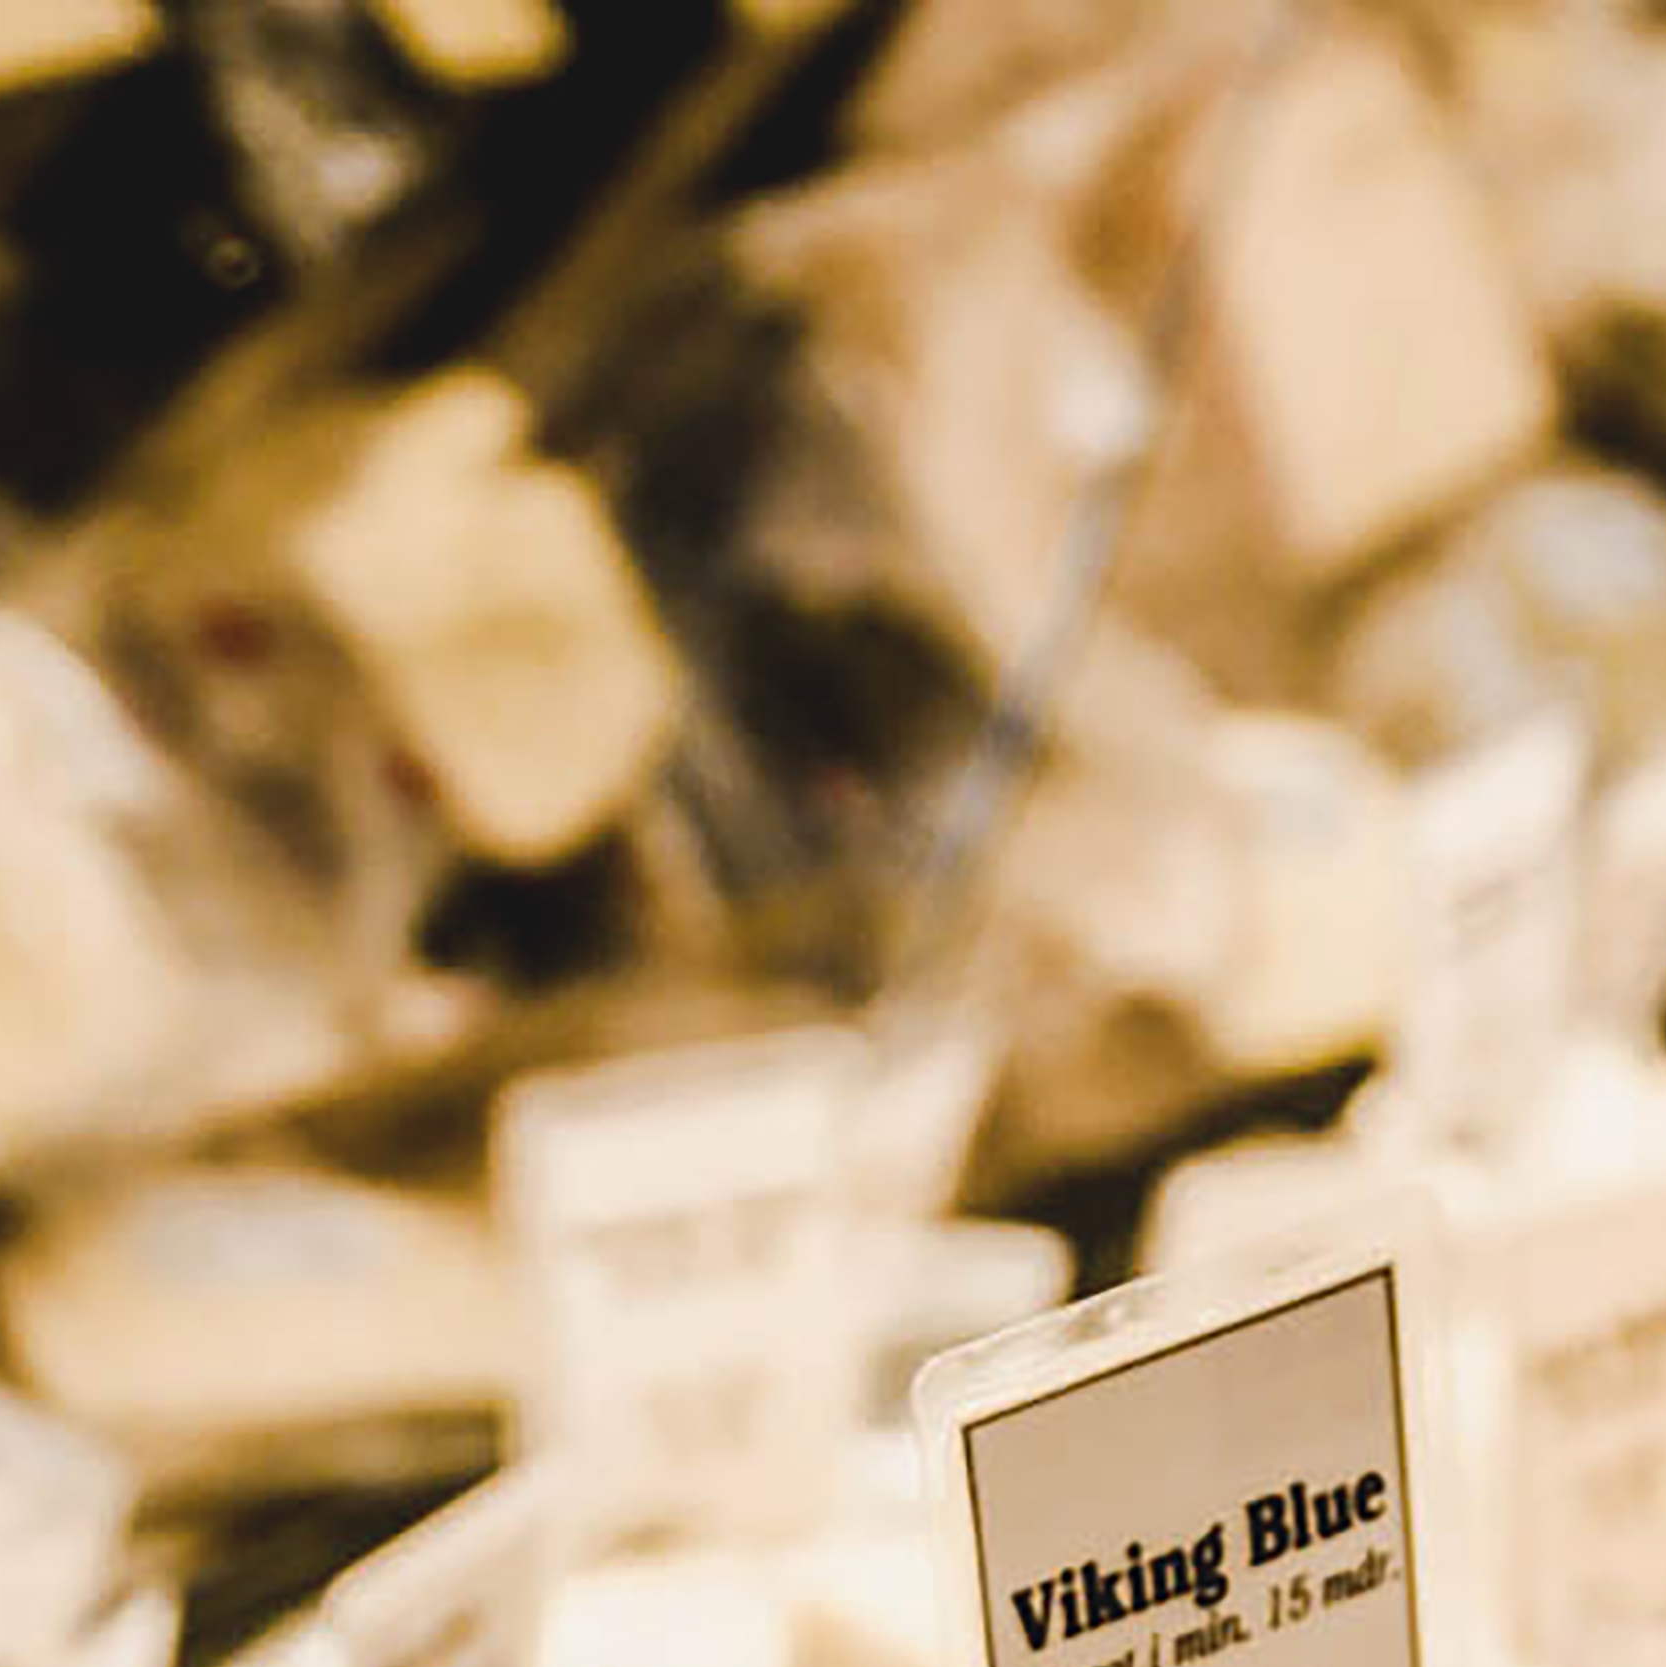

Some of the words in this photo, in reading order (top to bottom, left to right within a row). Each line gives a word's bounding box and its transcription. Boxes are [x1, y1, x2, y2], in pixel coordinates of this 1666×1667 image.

[1010, 1521, 1230, 1652] Viking
[1245, 1471, 1387, 1568] Blue
[1267, 1572, 1311, 1630] 15
[1320, 1546, 1401, 1608] mdr.
